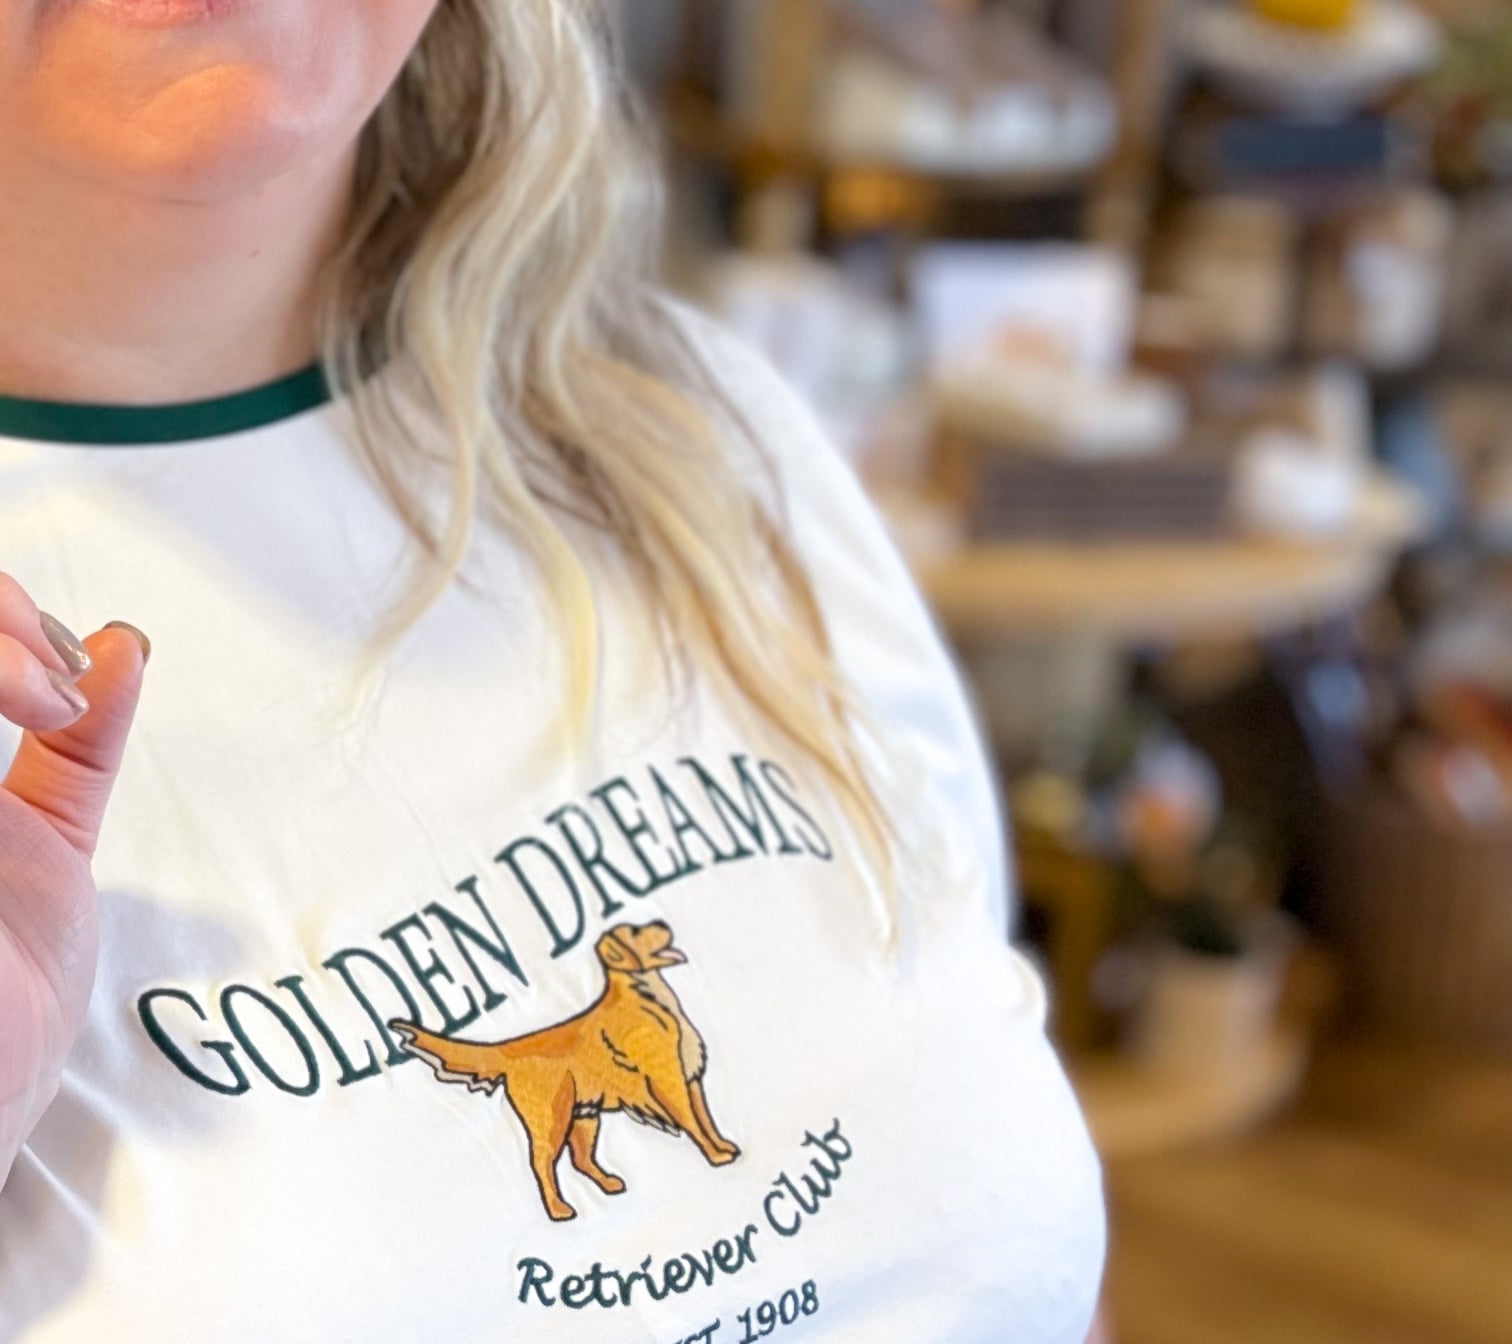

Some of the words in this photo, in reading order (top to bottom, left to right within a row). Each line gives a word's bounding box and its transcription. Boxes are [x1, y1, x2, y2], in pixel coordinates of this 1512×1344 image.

[137, 875, 529, 1097] GOLDEN
[495, 754, 833, 958] DREAMS
[517, 1223, 758, 1309] Retriever
[763, 1118, 853, 1236] Club
